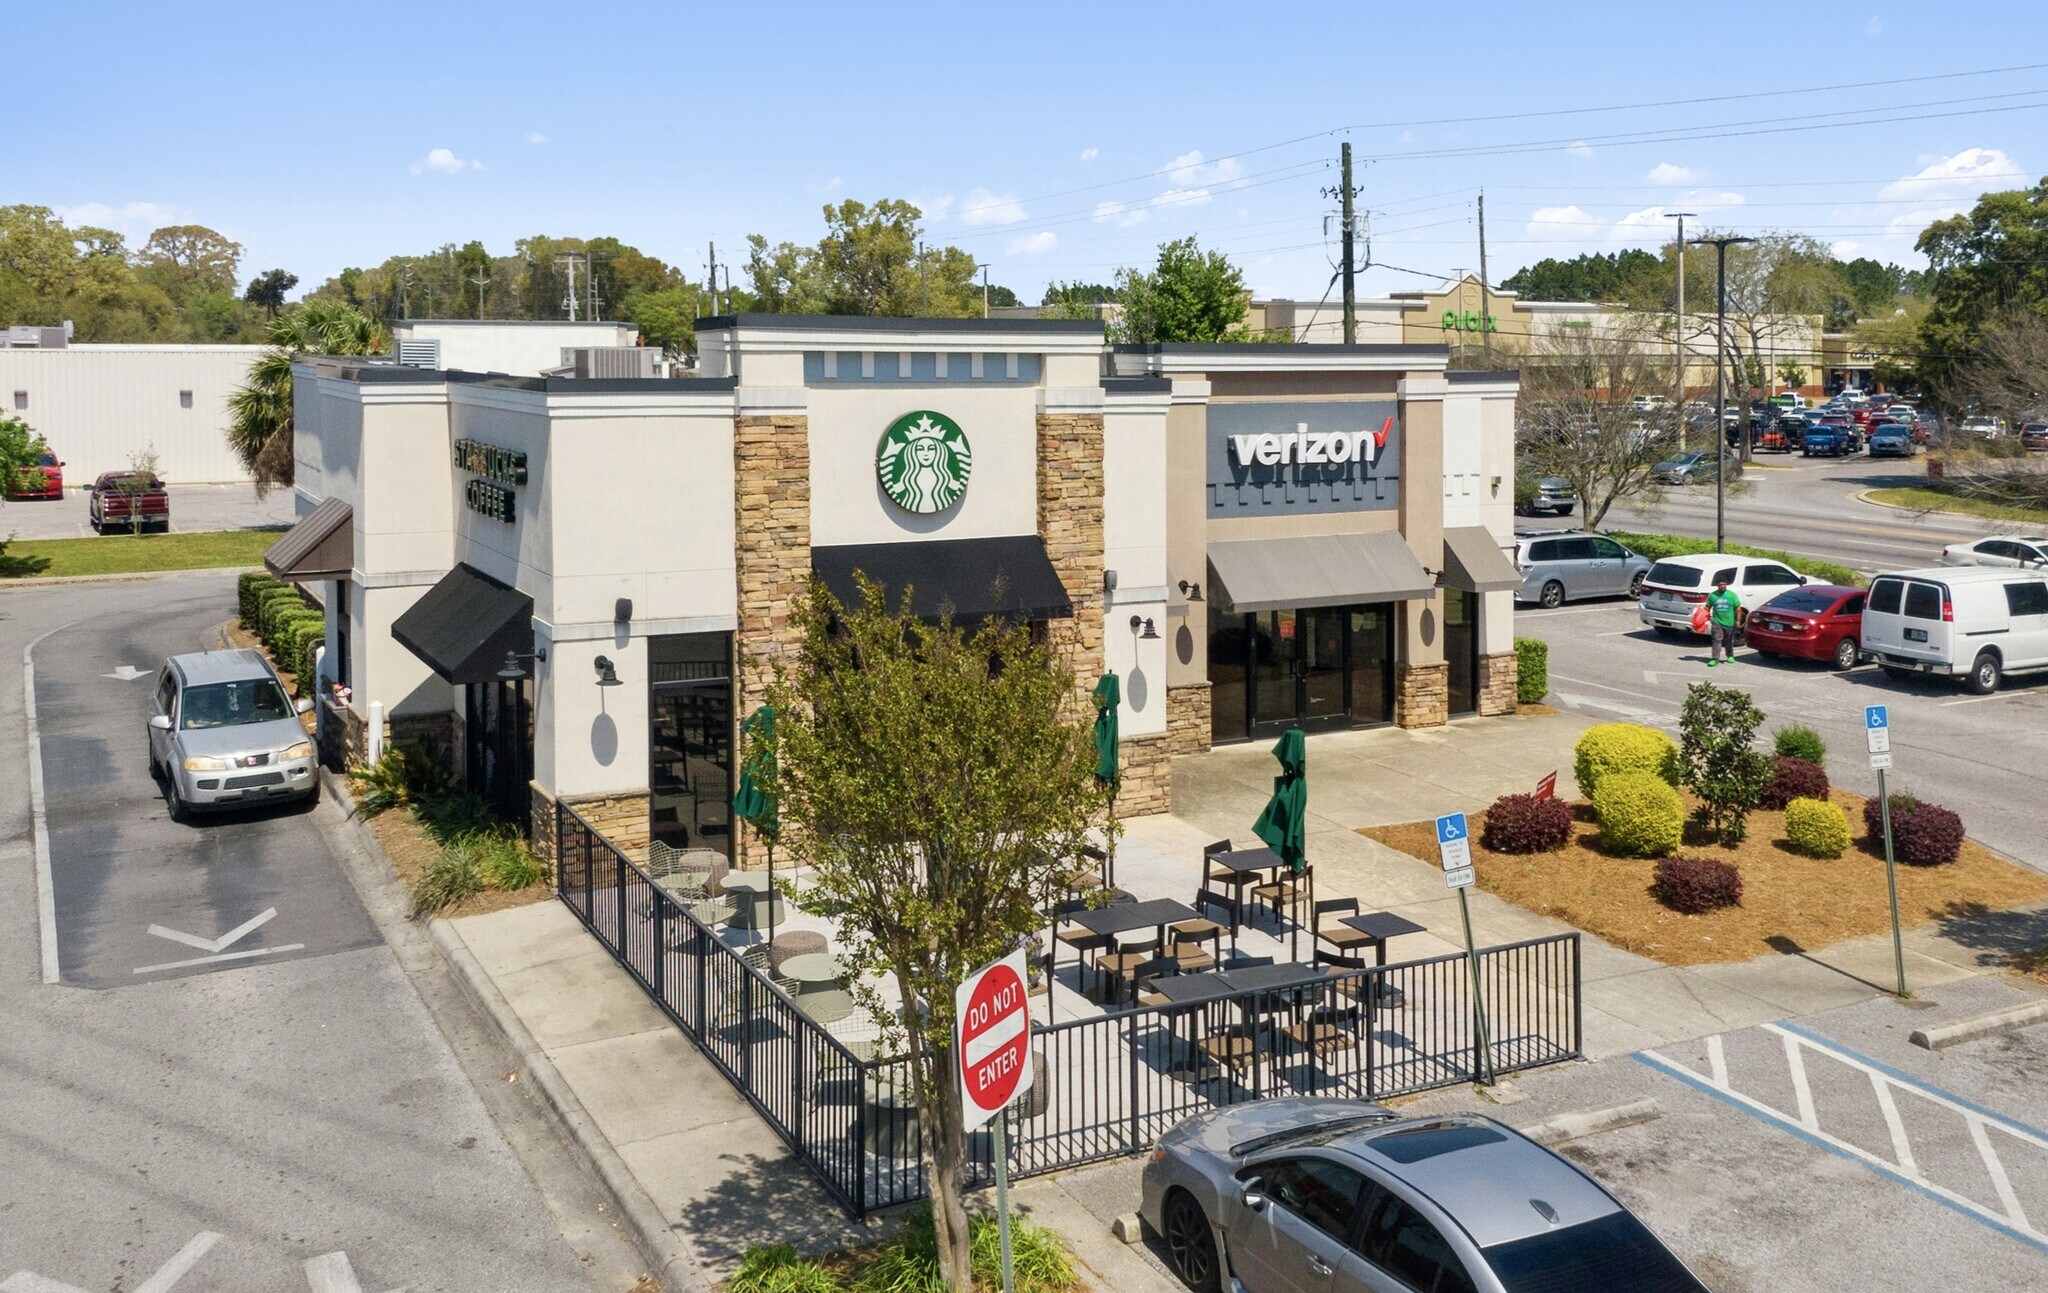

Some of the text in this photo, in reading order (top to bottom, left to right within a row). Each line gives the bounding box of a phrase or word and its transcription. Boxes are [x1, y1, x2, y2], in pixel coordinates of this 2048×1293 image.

[455, 438, 520, 486] STARBUCKS
[1231, 422, 1375, 466] verizon
[465, 479, 507, 523] COFFEE
[970, 981, 1018, 1031] DO NOT
[978, 1047, 1018, 1091] ENTER
